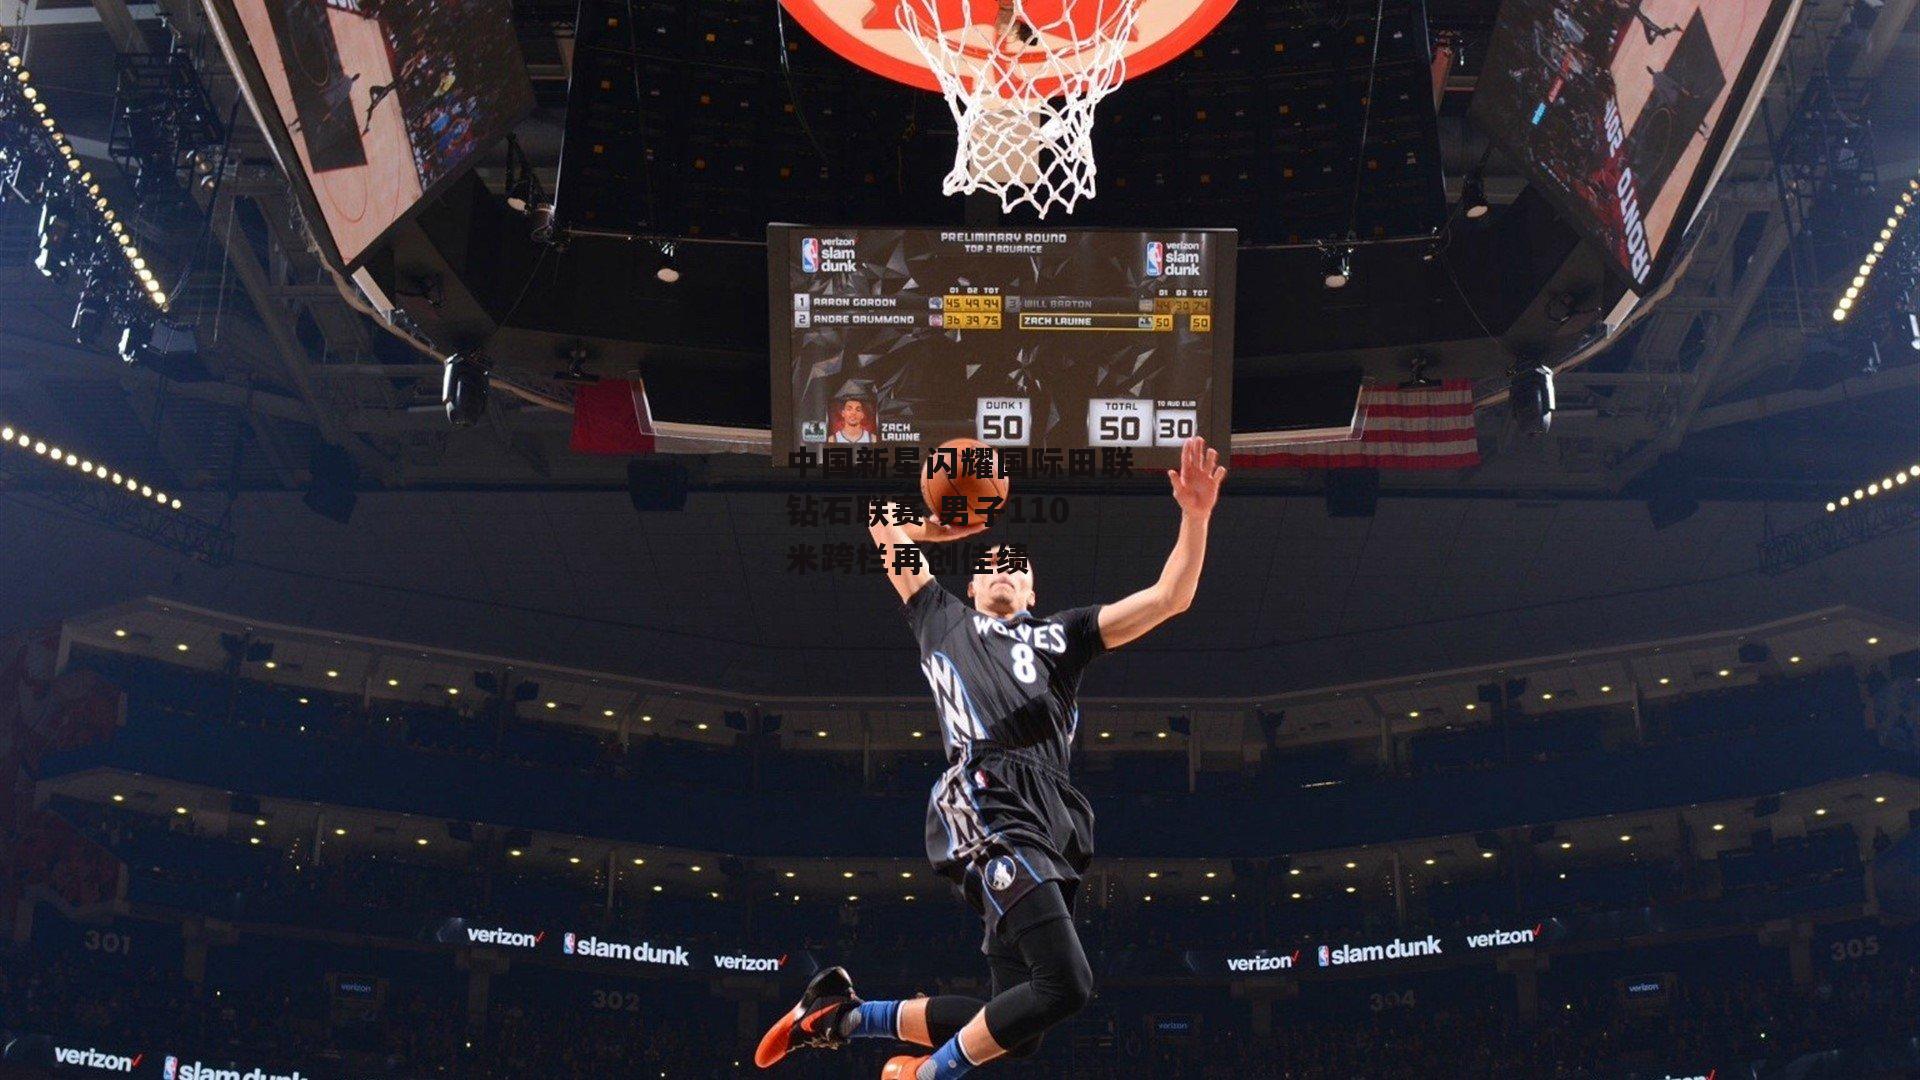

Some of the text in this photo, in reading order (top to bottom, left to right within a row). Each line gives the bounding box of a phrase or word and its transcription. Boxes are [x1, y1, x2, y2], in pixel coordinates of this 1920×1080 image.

[821, 237, 856, 246] verizon
[941, 232, 1067, 244] PRELIMINARY ROUND
[965, 244, 1043, 254] TOP 2 ADVANCE
[1165, 241, 1200, 250] verizon
[821, 246, 856, 259] slam
[1165, 250, 1200, 263] slam
[821, 259, 857, 272] dunk
[1164, 263, 1200, 276] dunk
[813, 298, 850, 307] AARON
[852, 298, 897, 307] GORDON
[946, 298, 960, 308] 45
[965, 298, 980, 308] 49
[983, 298, 999, 308] 94
[1024, 299, 1047, 308] WILL
[1050, 299, 1092, 309] BARTON
[813, 315, 850, 324] ANDRE
[852, 315, 915, 324] DRUMMOND
[946, 315, 960, 325] 36
[966, 315, 980, 325] 39
[983, 315, 999, 326] 75
[1024, 317, 1208, 328] ZACH LAVINE 50 50
[986, 401, 1015, 410] DUNK
[1105, 402, 1138, 411] TOTAL
[881, 423, 911, 432] ZACH
[983, 415, 1023, 440] 50
[1100, 416, 1140, 440] 50
[1160, 418, 1193, 439] 30
[881, 433, 920, 442] LAVINE
[1011, 643, 1037, 683] 8
[84, 930, 131, 955] 301
[467, 927, 536, 947] verizon
[1466, 928, 1534, 949] verizon
[577, 936, 689, 967] slam dunk
[1331, 935, 1442, 965] slam dunk
[1831, 935, 1879, 960] 305
[714, 954, 779, 971] verizon
[1227, 953, 1292, 971] verizon
[340, 982, 371, 992] verizon
[1629, 983, 1660, 992] verizon
[592, 989, 640, 1011] 302
[54, 1046, 132, 1072] verizon
[178, 1061, 240, 1080] slam
